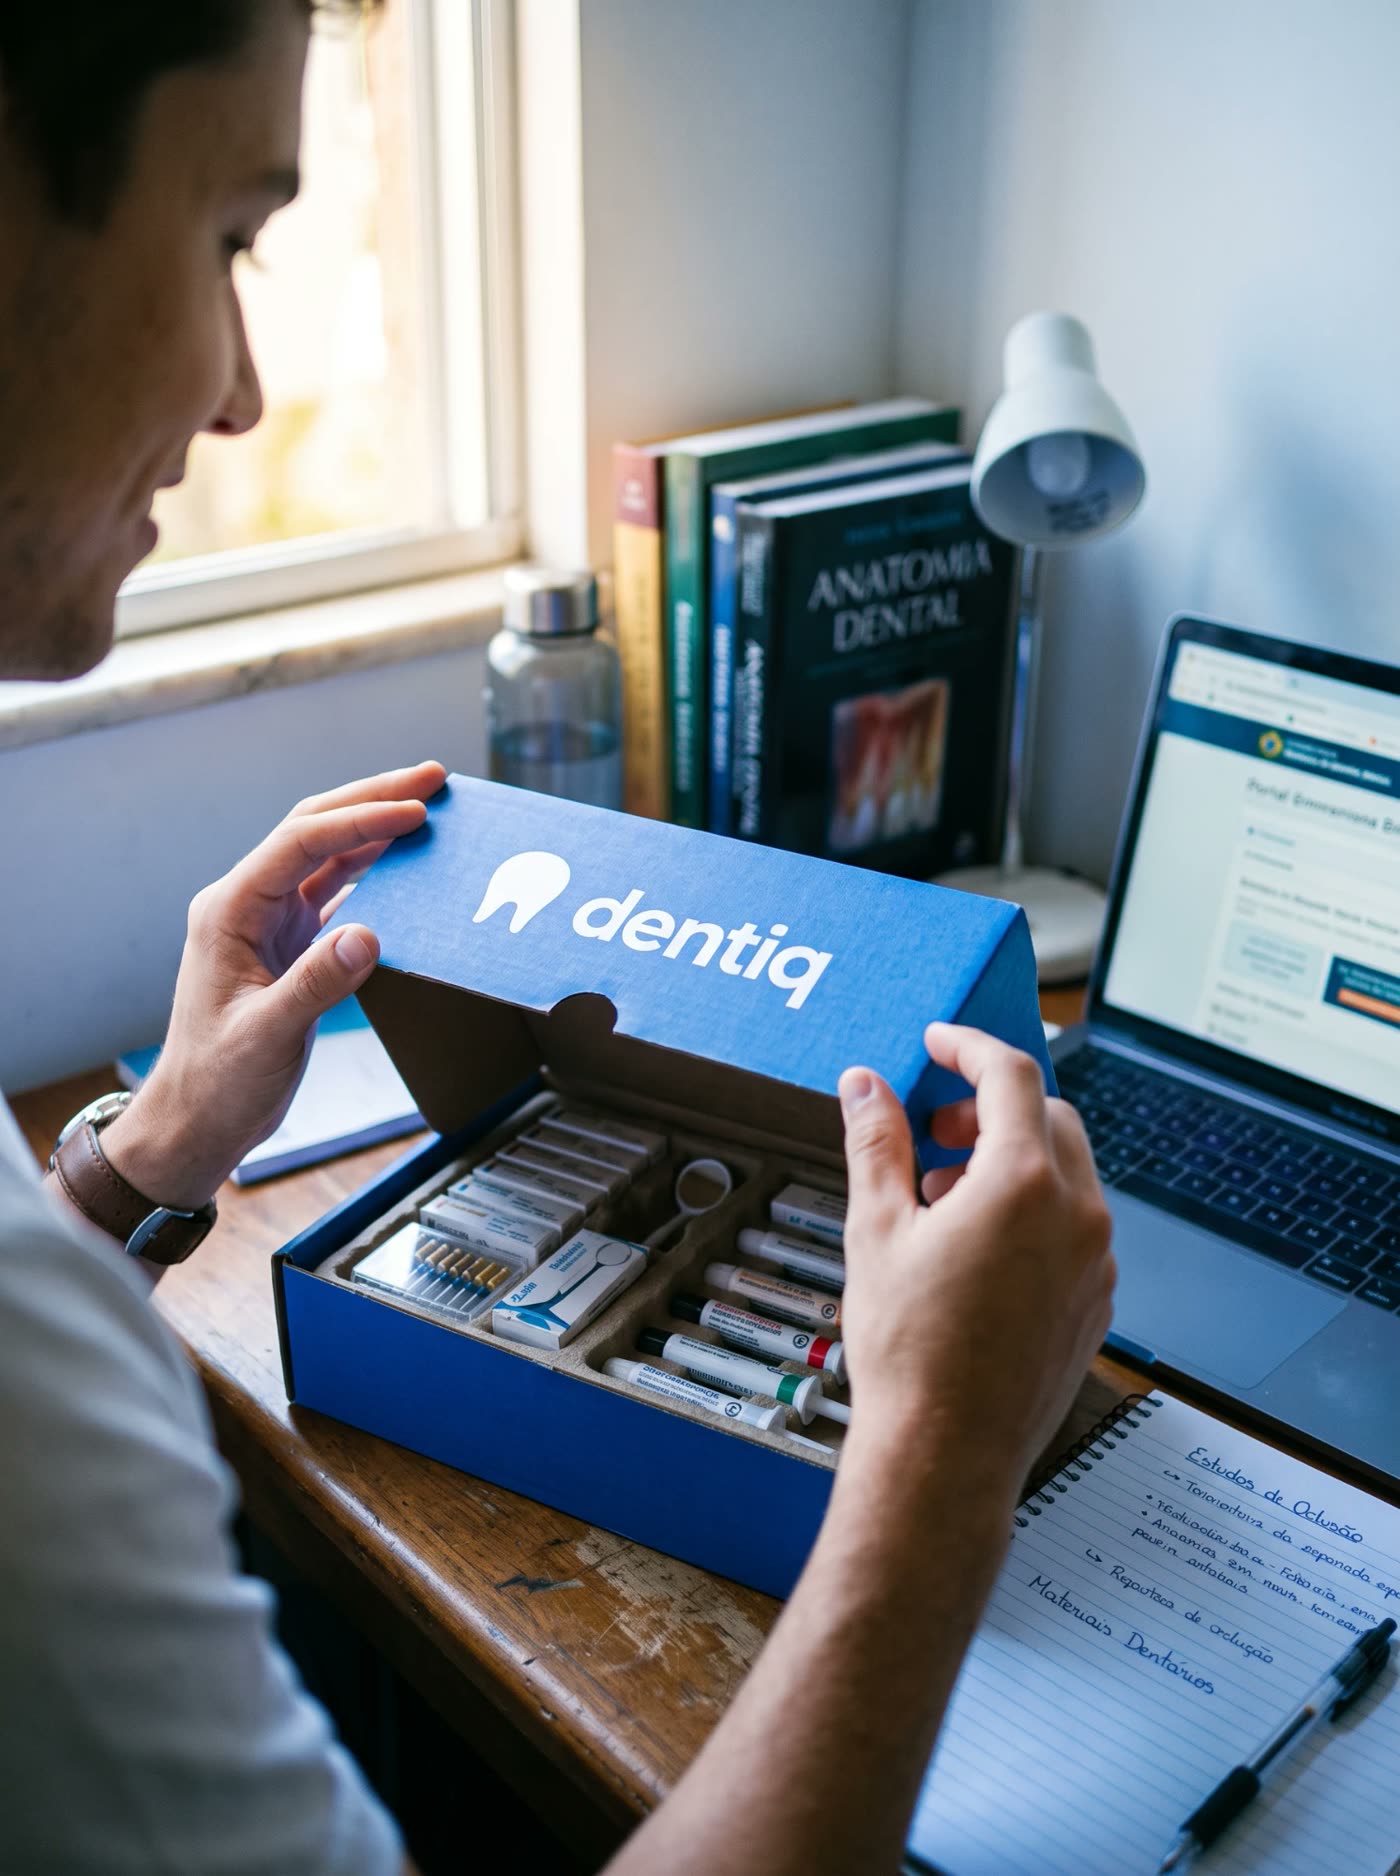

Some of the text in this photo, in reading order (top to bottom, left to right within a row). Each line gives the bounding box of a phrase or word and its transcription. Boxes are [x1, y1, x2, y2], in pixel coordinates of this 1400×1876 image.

[806, 537, 992, 612] ANATOMIA
[833, 588, 961, 652] DENTAL
[572, 889, 833, 1010] dentiq
[1185, 1446, 1364, 1545] Estudos de Oclusão
[1027, 1575, 1215, 1696] Materiais Dentários
[1184, 1609, 1202, 1625] de
